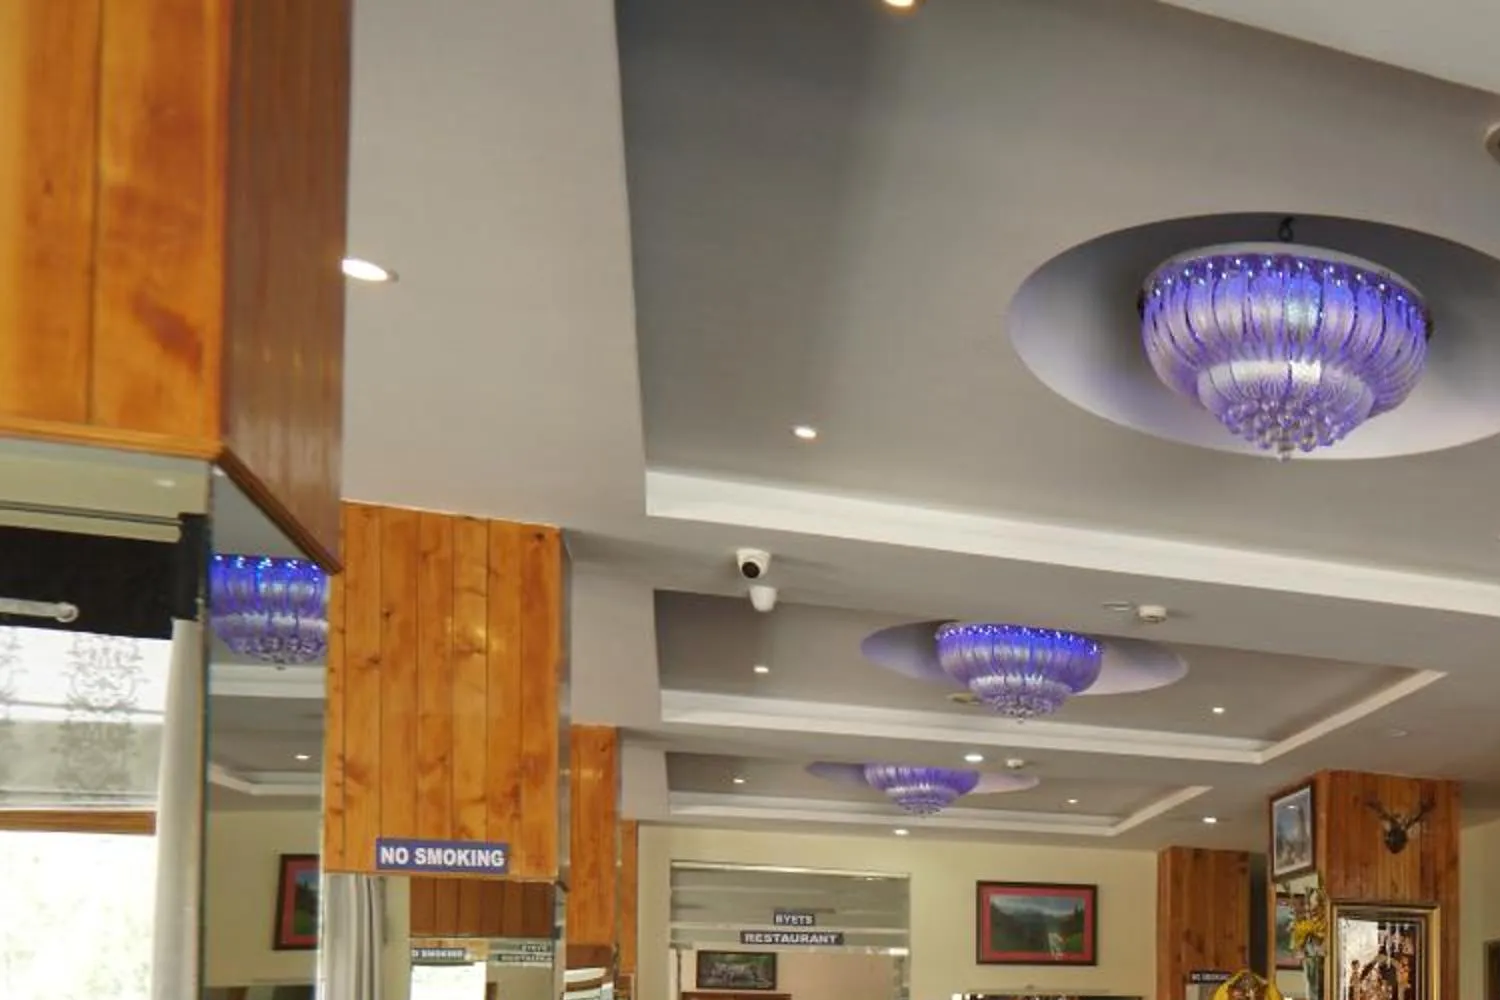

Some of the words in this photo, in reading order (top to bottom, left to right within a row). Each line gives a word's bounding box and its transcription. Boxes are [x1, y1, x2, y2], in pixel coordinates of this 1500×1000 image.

[381, 846, 409, 865] NO
[415, 847, 505, 867] SMOKING
[744, 933, 837, 943] RESTAURANT
